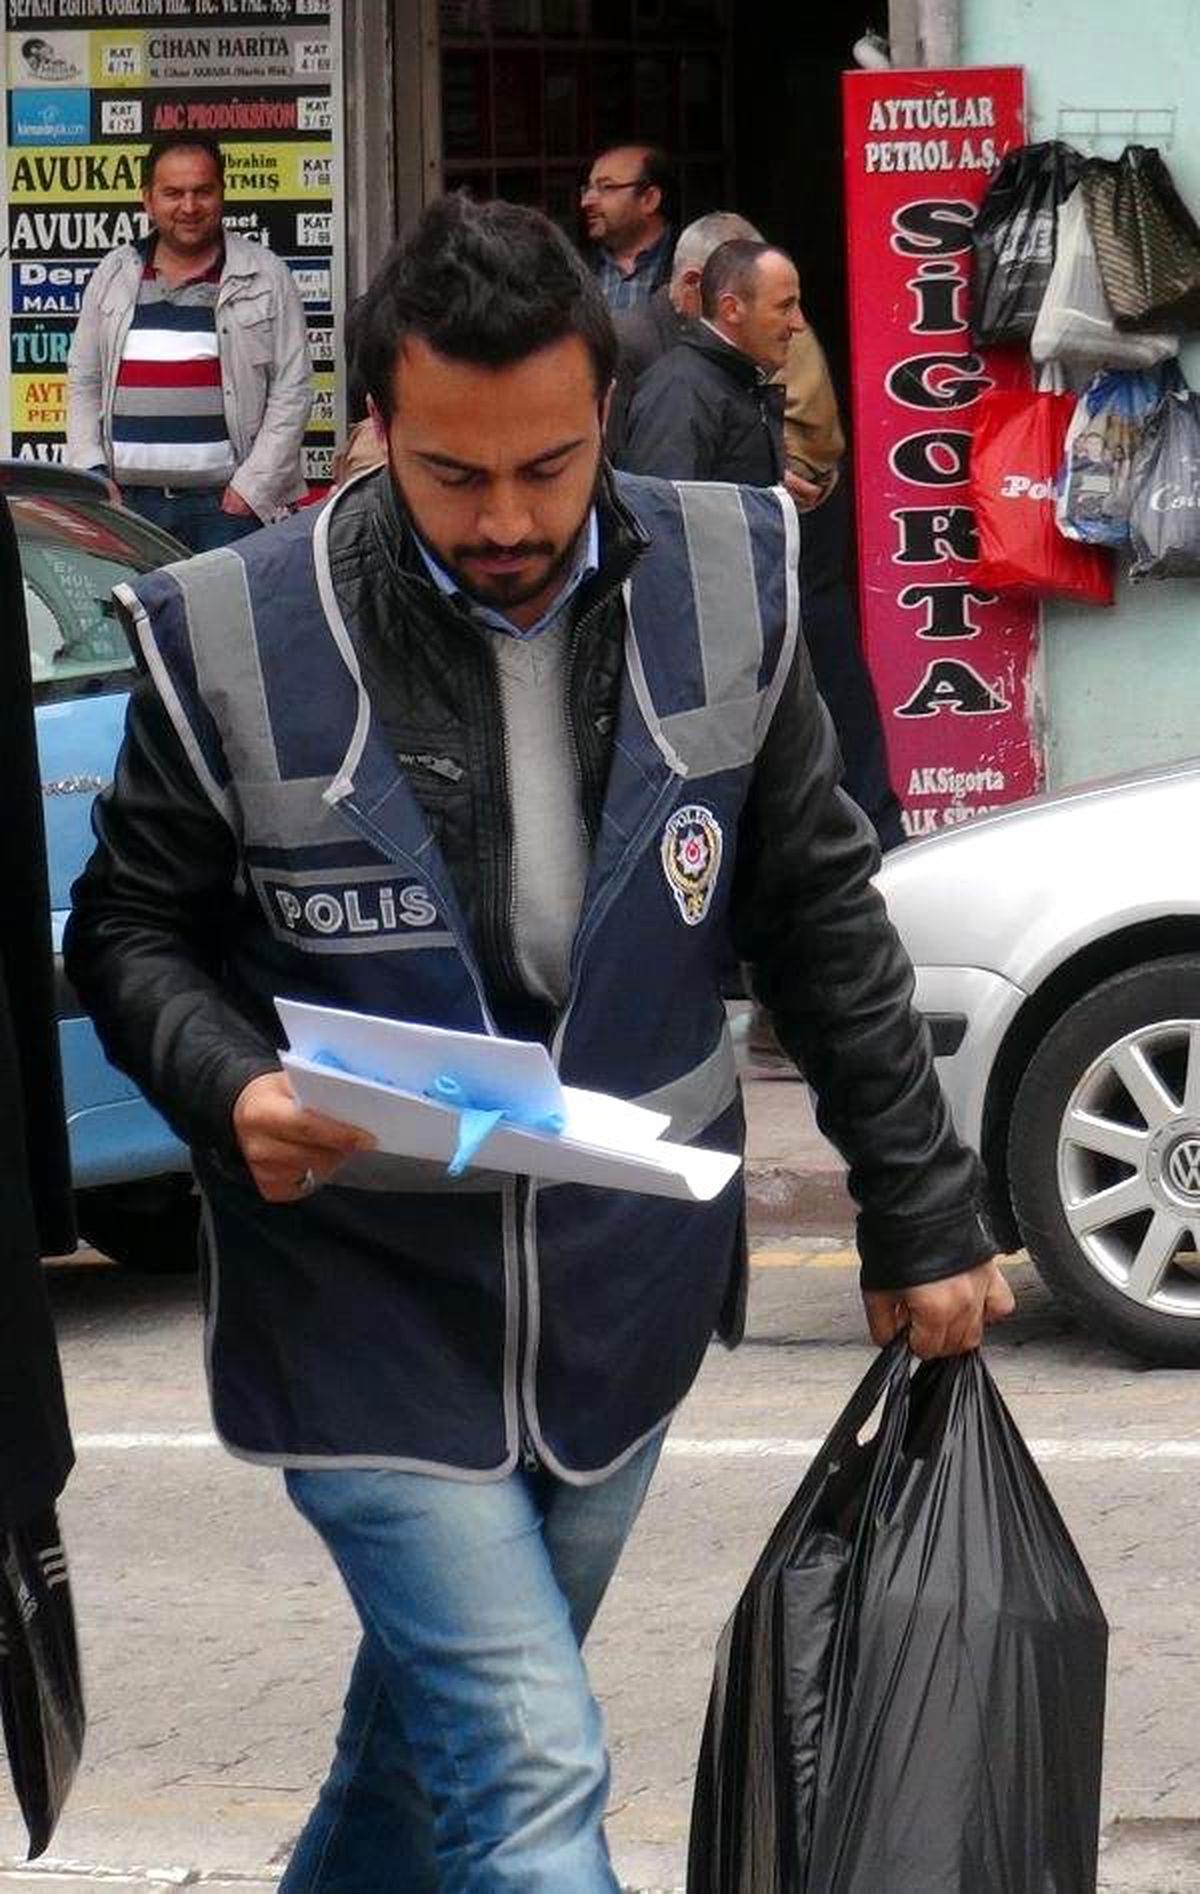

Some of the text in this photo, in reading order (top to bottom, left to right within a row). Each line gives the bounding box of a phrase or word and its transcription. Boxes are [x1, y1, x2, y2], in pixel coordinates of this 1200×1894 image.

[109, 48, 133, 58] KAT
[148, 32, 290, 59] CİHAN HARİTA
[303, 44, 328, 56] KAT
[110, 105, 132, 116] KAT
[305, 100, 329, 112] KAT
[868, 90, 995, 131] AYTUĞLAR
[303, 159, 332, 172] KAT
[864, 142, 953, 173] PETROL
[12, 154, 150, 192] AVUKAT
[223, 174, 280, 193] TMIŞ
[12, 212, 150, 250] AVUKAT
[303, 217, 332, 230] KAT
[12, 323, 75, 363] TÜR
[29, 409, 66, 422] PET
[907, 766, 1005, 799] AKSigorta
